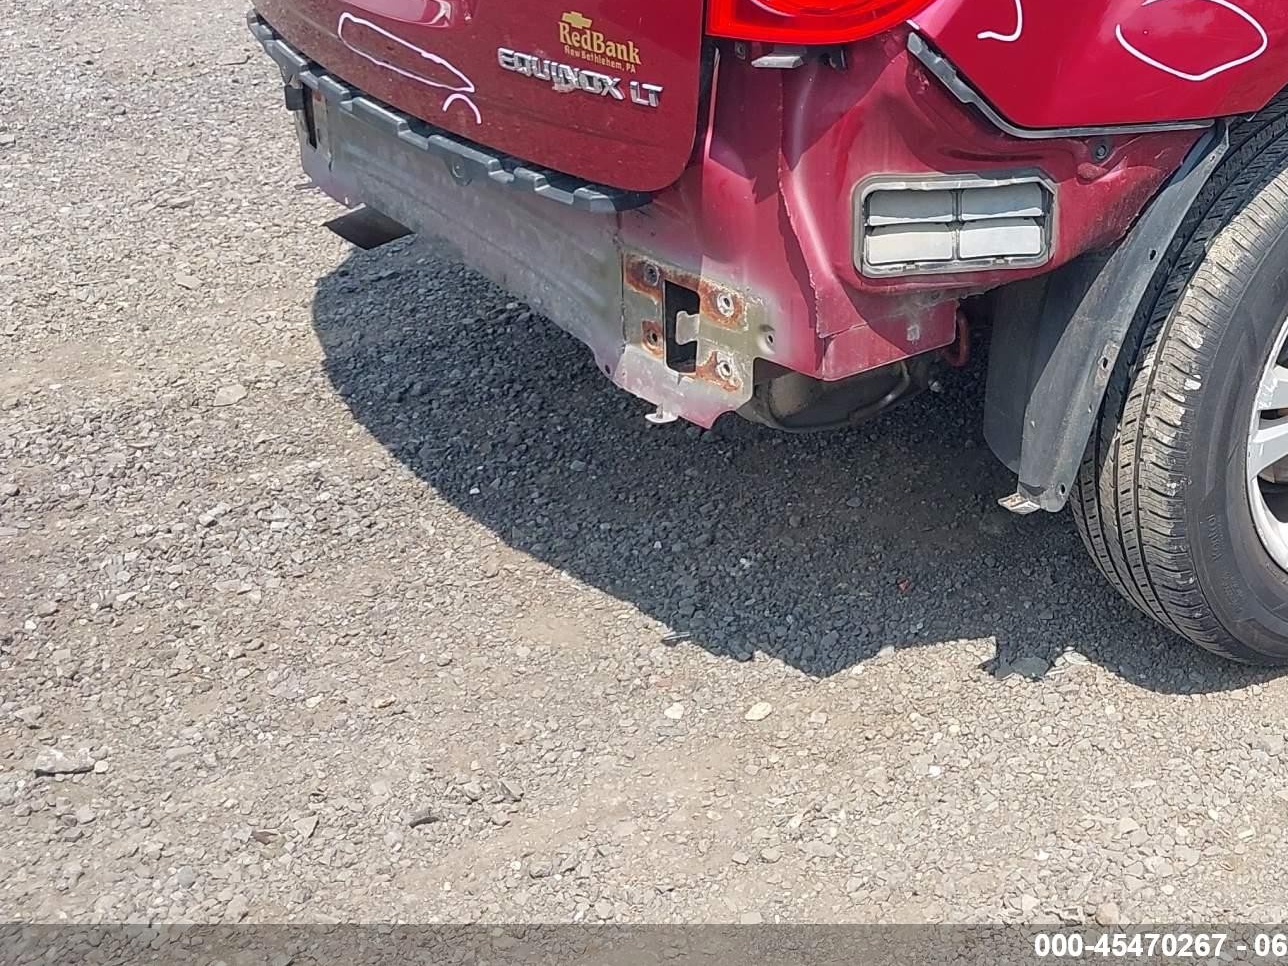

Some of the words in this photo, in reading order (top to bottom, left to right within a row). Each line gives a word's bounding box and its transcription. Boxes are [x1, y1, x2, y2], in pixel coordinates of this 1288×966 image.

[558, 21, 642, 65] RedBank
[497, 47, 626, 100] EQUINOX
[629, 80, 664, 108] LT
[625, 63, 637, 74] PA
